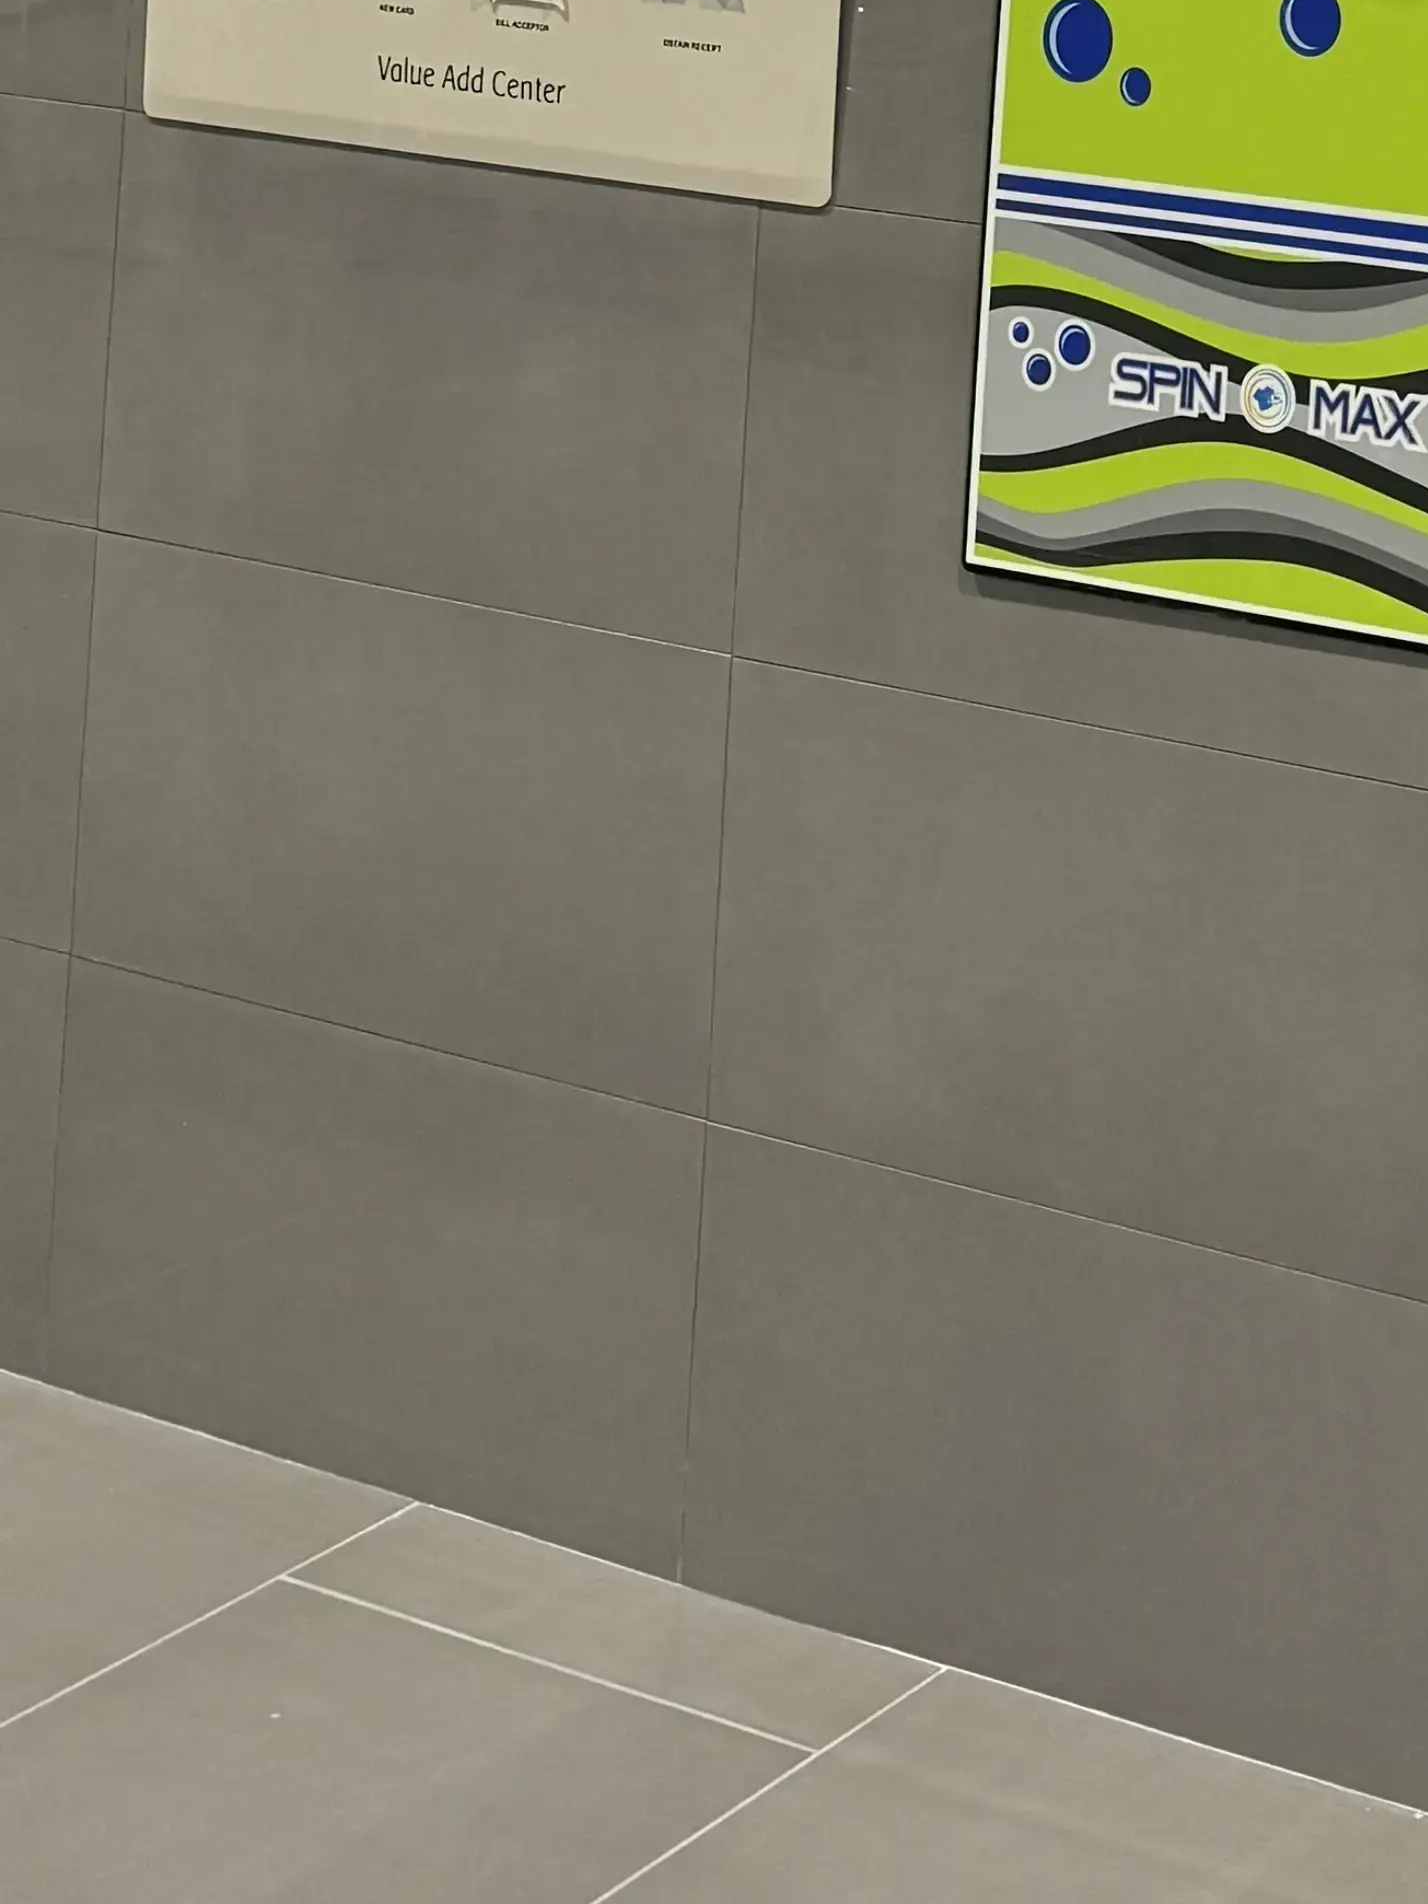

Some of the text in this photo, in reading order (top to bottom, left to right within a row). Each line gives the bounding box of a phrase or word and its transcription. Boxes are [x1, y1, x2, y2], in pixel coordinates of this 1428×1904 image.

[378, 55, 566, 104] Value Add Center
[1112, 356, 1426, 449] SPIN MAX
